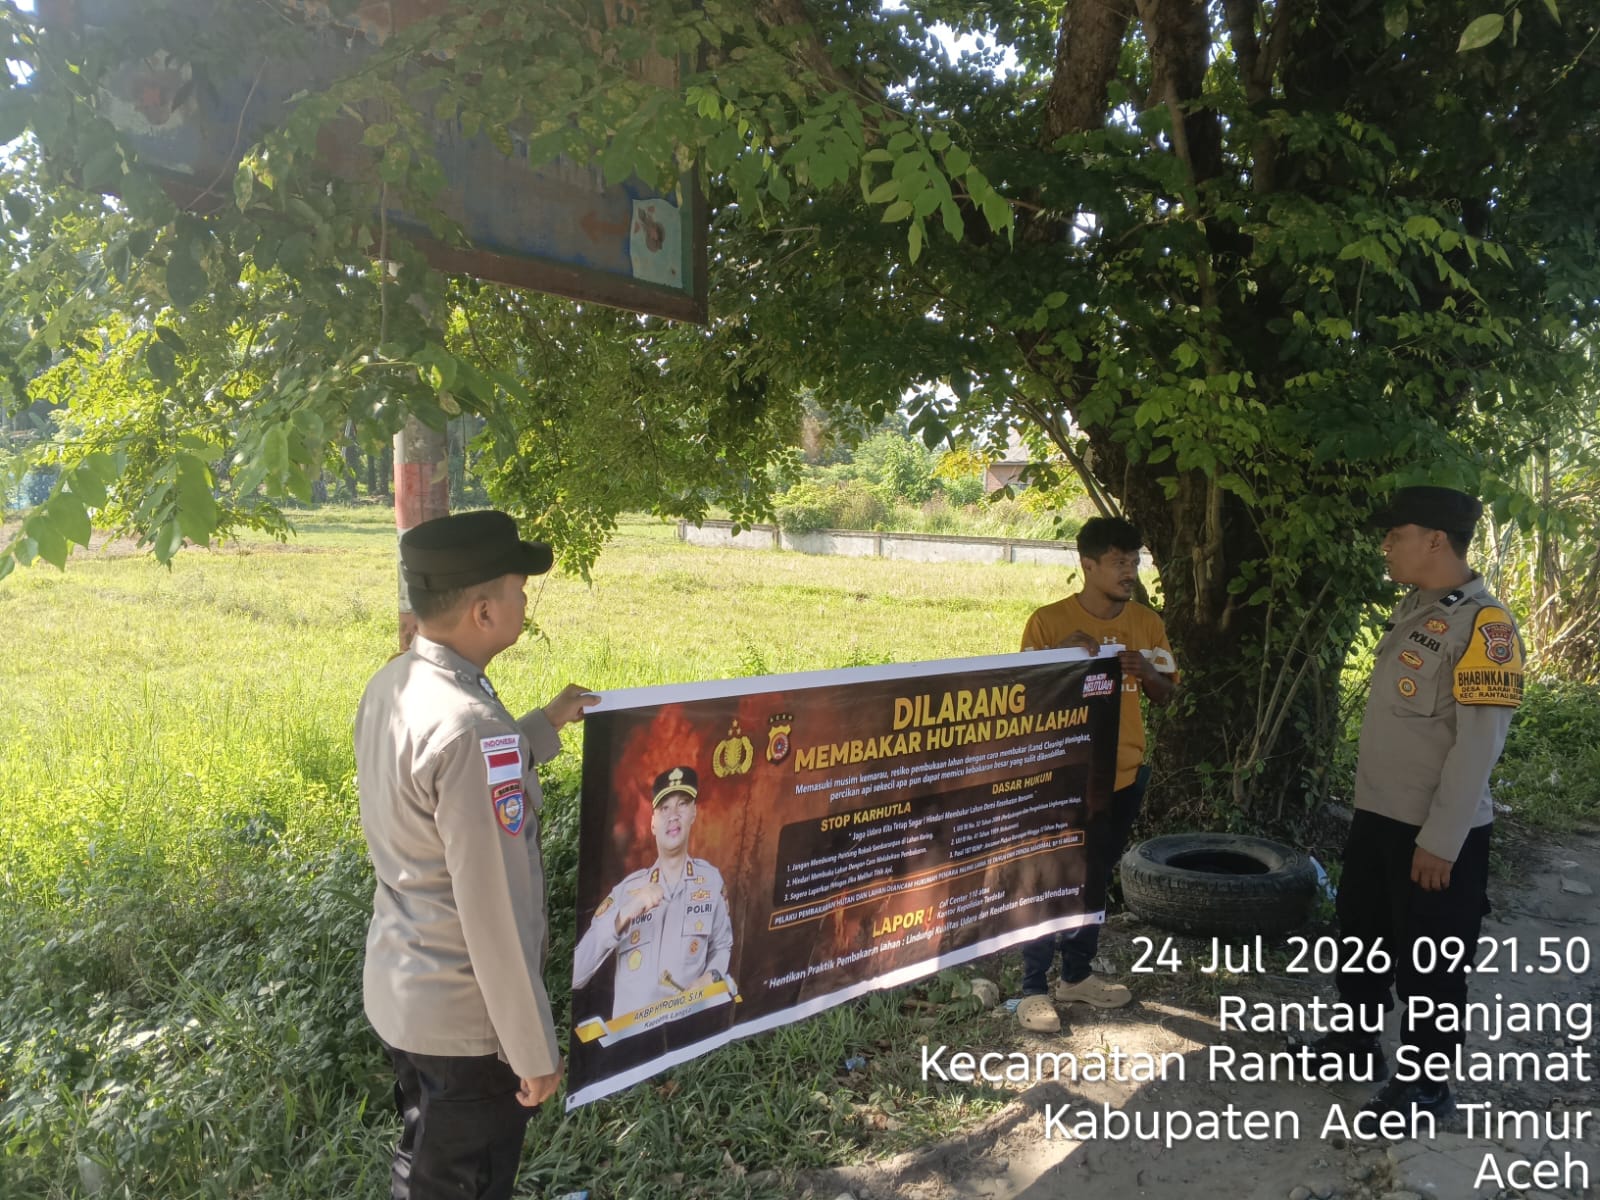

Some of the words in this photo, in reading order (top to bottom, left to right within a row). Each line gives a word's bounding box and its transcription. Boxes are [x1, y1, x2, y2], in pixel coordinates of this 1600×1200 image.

[1409, 631, 1440, 652] POLRI
[893, 684, 1025, 731] DILARANG
[483, 737, 516, 748] INDONESIA
[794, 731, 922, 773] MEMBAKAR
[926, 721, 991, 751] HUTAN
[995, 715, 1034, 740] DAN
[1035, 705, 1089, 732] LAHAN
[795, 779, 833, 795] Memasuki
[834, 777, 858, 787] musim
[860, 772, 889, 783] kemarau,
[890, 766, 910, 777] resiko
[911, 761, 947, 776] pembukaan
[947, 757, 964, 767] lahan
[830, 787, 861, 802] percikan
[861, 785, 873, 796] api
[873, 780, 895, 793] sekecil
[896, 779, 908, 790] apa
[909, 777, 922, 788] pun
[923, 772, 940, 784] dapat
[941, 769, 965, 779] memicu
[993, 760, 1009, 769] besar
[1009, 758, 1023, 769] yang
[991, 779, 1022, 795] DASAR
[1024, 771, 1053, 788] HUKUM
[820, 814, 851, 833] STOP
[853, 802, 912, 825] KARHUTLA
[686, 903, 712, 914] POLRI
[774, 913, 798, 926] PELAKU
[836, 894, 855, 908] HUTAN
[855, 890, 868, 901] DAN
[949, 894, 969, 905] Center
[872, 909, 925, 938] LAPOR
[927, 906, 934, 921] !
[769, 971, 806, 989] Hentikan
[807, 960, 834, 977] Praktik
[879, 939, 901, 952] Lahan
[906, 927, 935, 945] Lindungi
[978, 909, 989, 920] dan
[634, 1006, 654, 1020] AKBP
